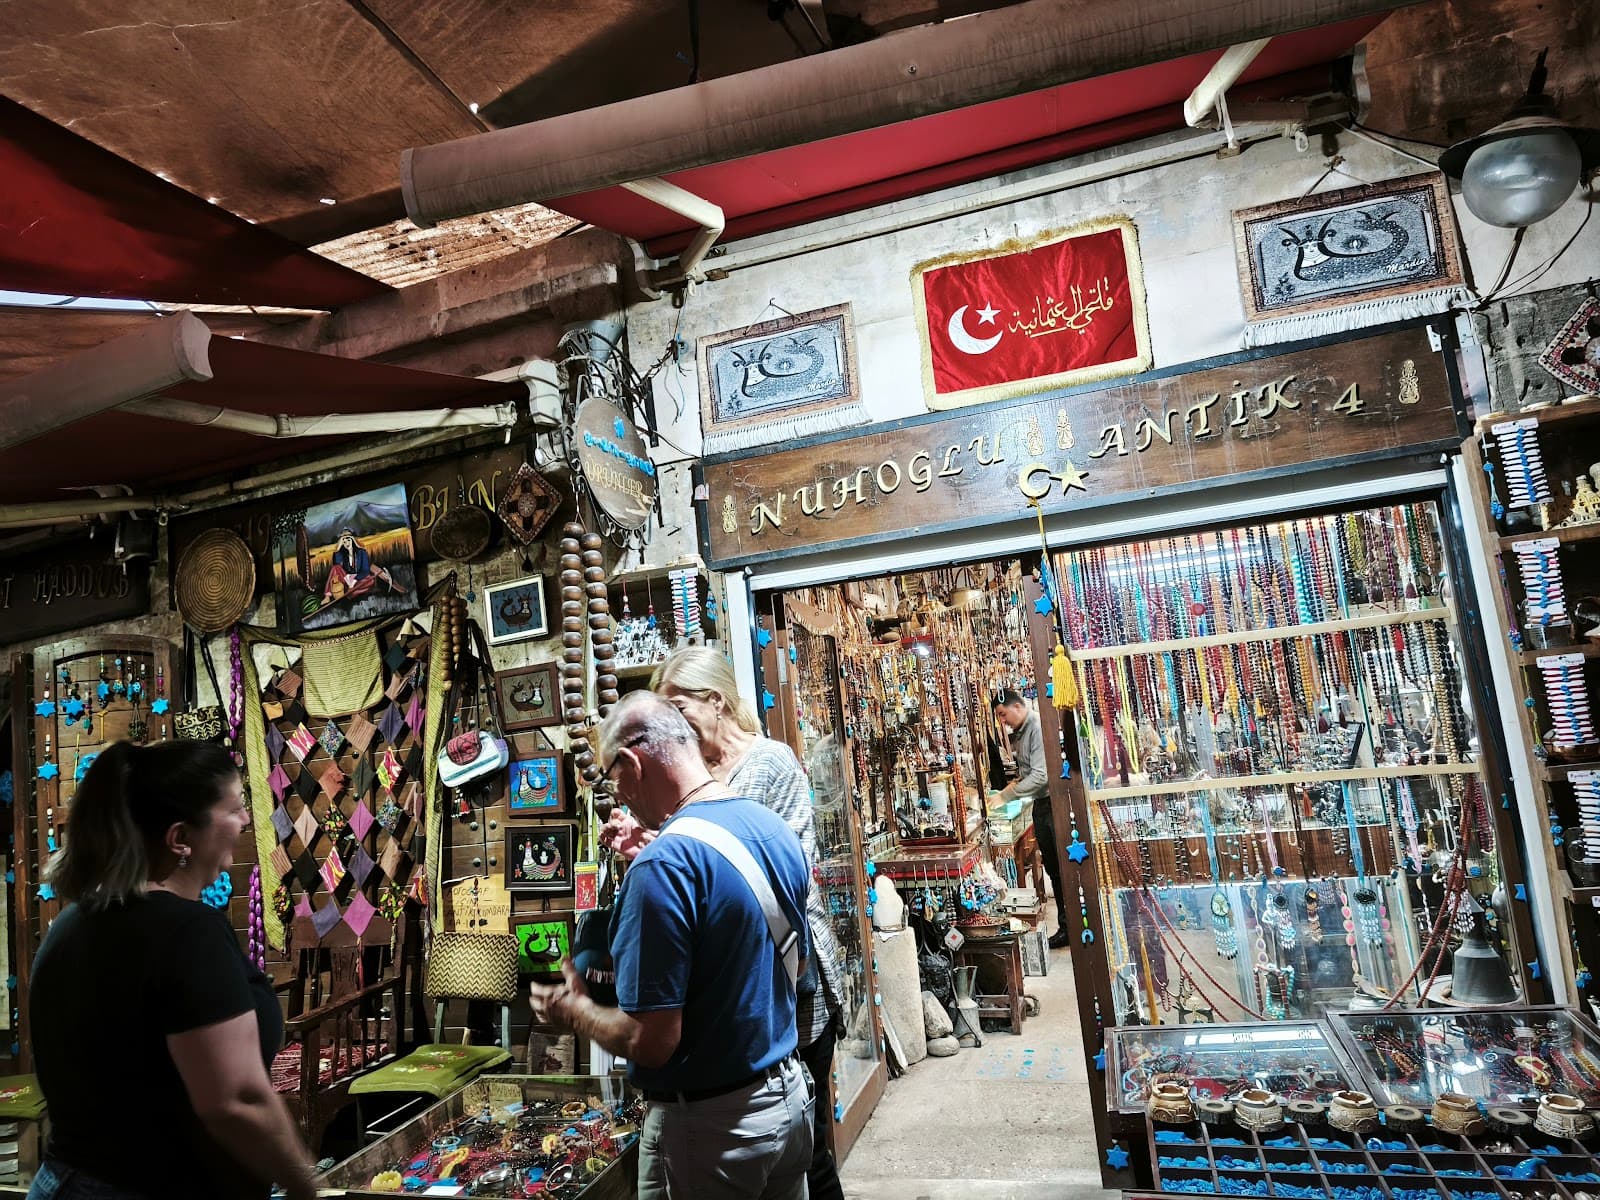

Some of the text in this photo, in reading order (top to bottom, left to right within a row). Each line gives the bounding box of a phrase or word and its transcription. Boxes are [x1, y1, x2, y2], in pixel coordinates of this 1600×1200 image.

[1386, 258, 1426, 274] Mardin
[1088, 374, 1302, 459] ANTİK
[1333, 382, 1364, 415] 4
